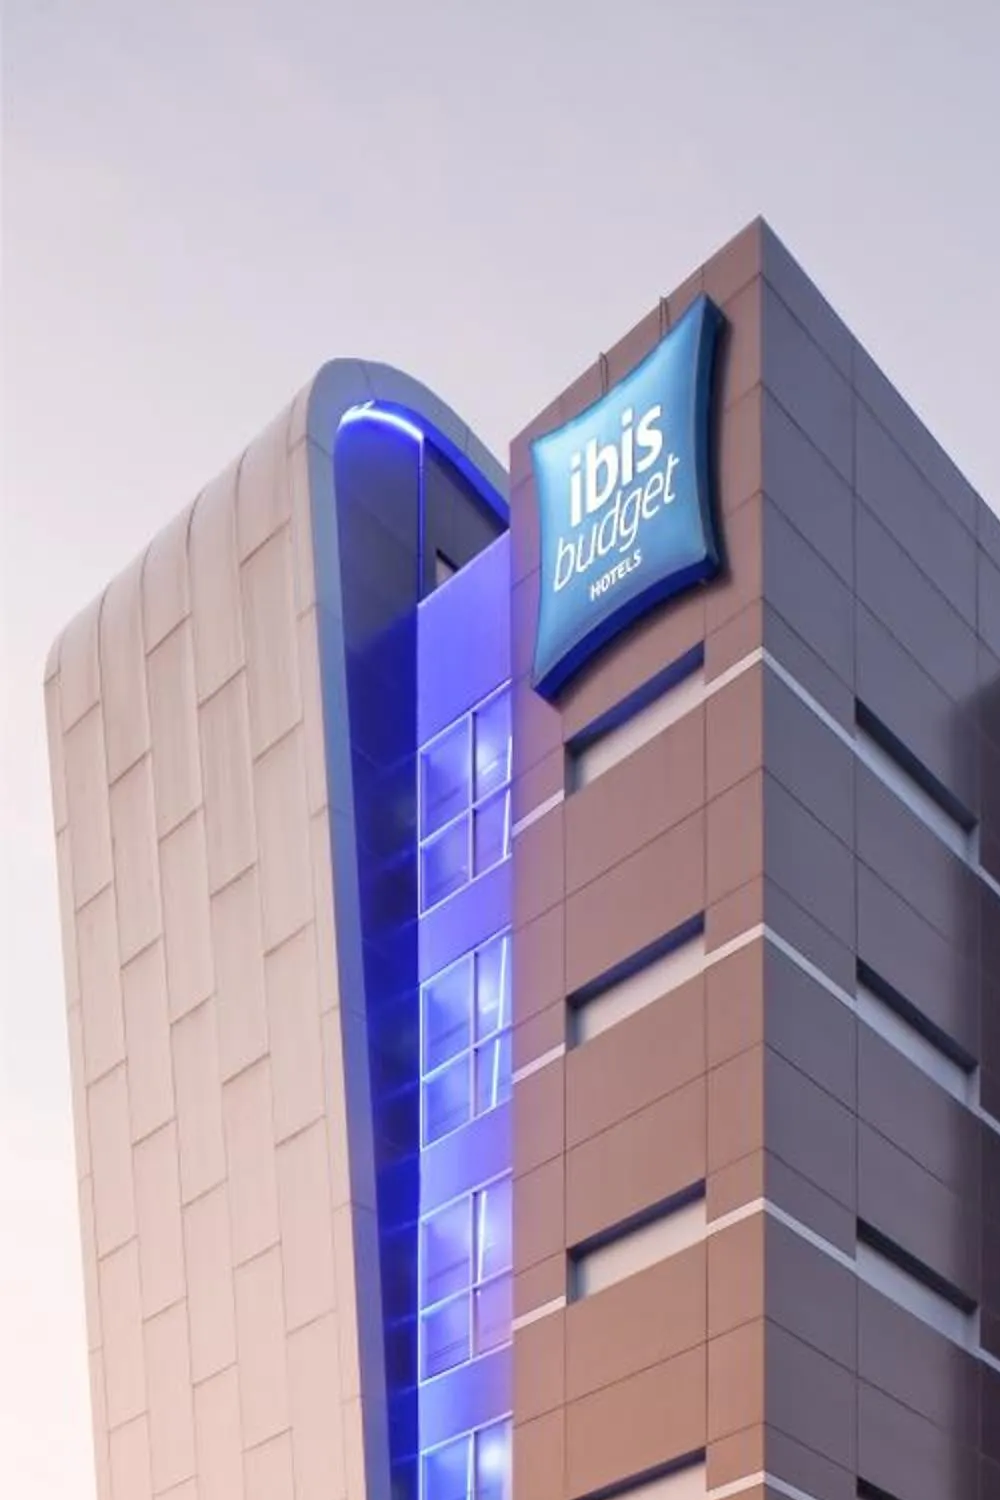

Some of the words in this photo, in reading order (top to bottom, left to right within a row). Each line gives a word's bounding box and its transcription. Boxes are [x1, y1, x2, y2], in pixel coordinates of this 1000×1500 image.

[554, 453, 679, 592] budget
[570, 405, 662, 526] ibis
[590, 549, 642, 600] HOTELS
